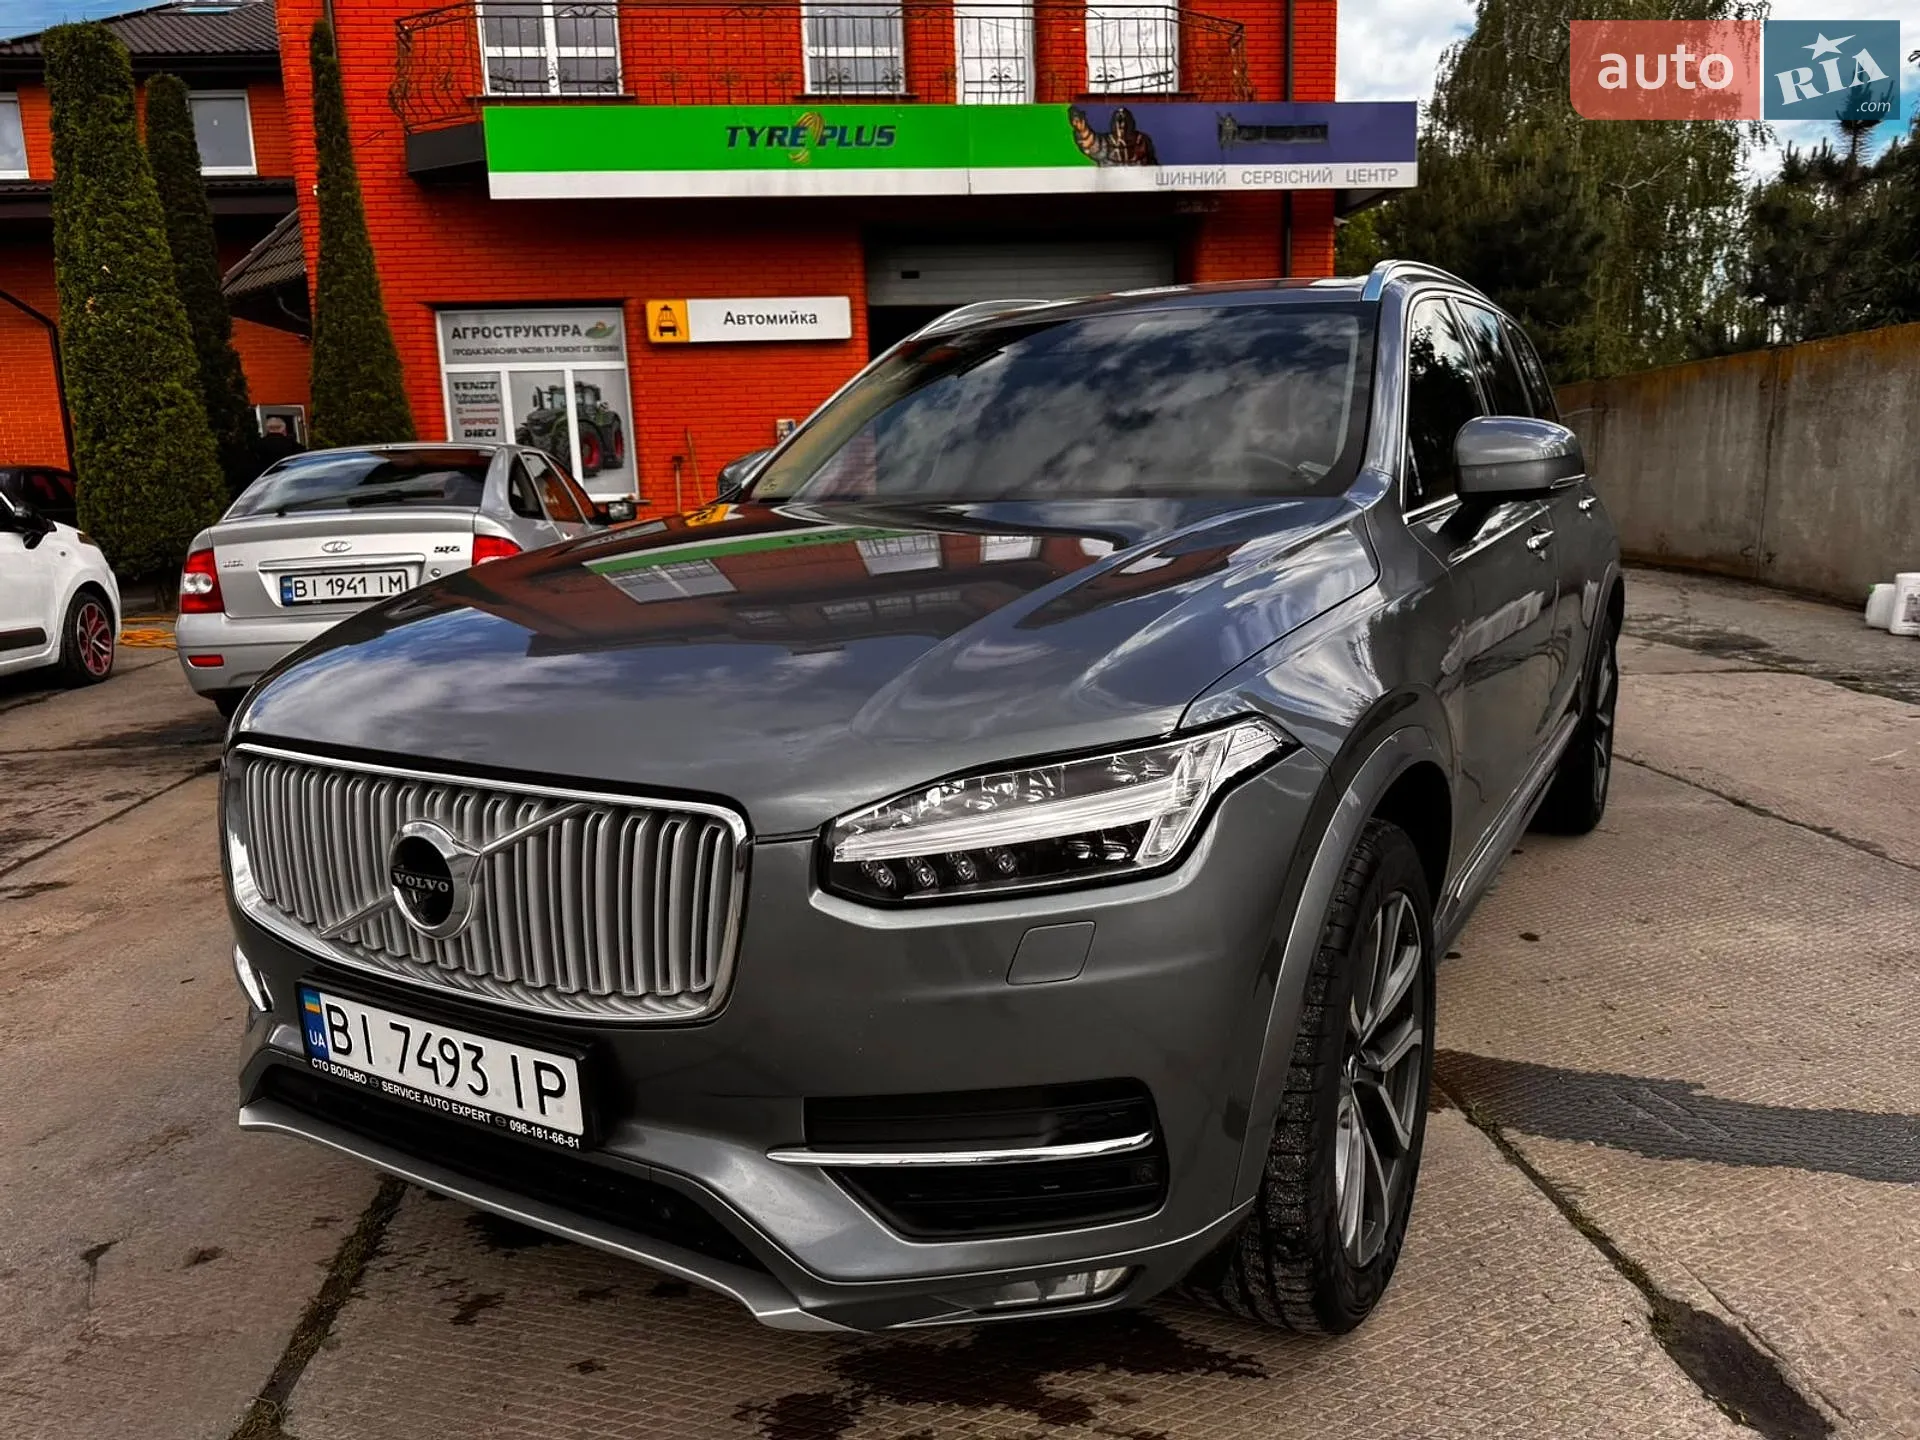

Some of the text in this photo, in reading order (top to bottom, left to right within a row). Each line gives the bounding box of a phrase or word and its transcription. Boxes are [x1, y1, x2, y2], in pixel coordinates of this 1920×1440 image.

[726, 125, 897, 148] TYRE PLUS
[1155, 166, 1399, 186] ШИННИЙ СЕРВІСНИЙ ЦЕНТР
[723, 310, 818, 326] Автомийка
[452, 324, 582, 340] АГРОСТРУКТУРА
[294, 575, 403, 597] BI 1941 IM
[393, 872, 449, 893] VOLVO
[309, 1029, 327, 1048] UA
[325, 1002, 568, 1116] BI 7493 IP
[311, 1057, 581, 1150] СТО ВОЛЬВО SERVICE AUTO EXPERT 096-181-66-81
